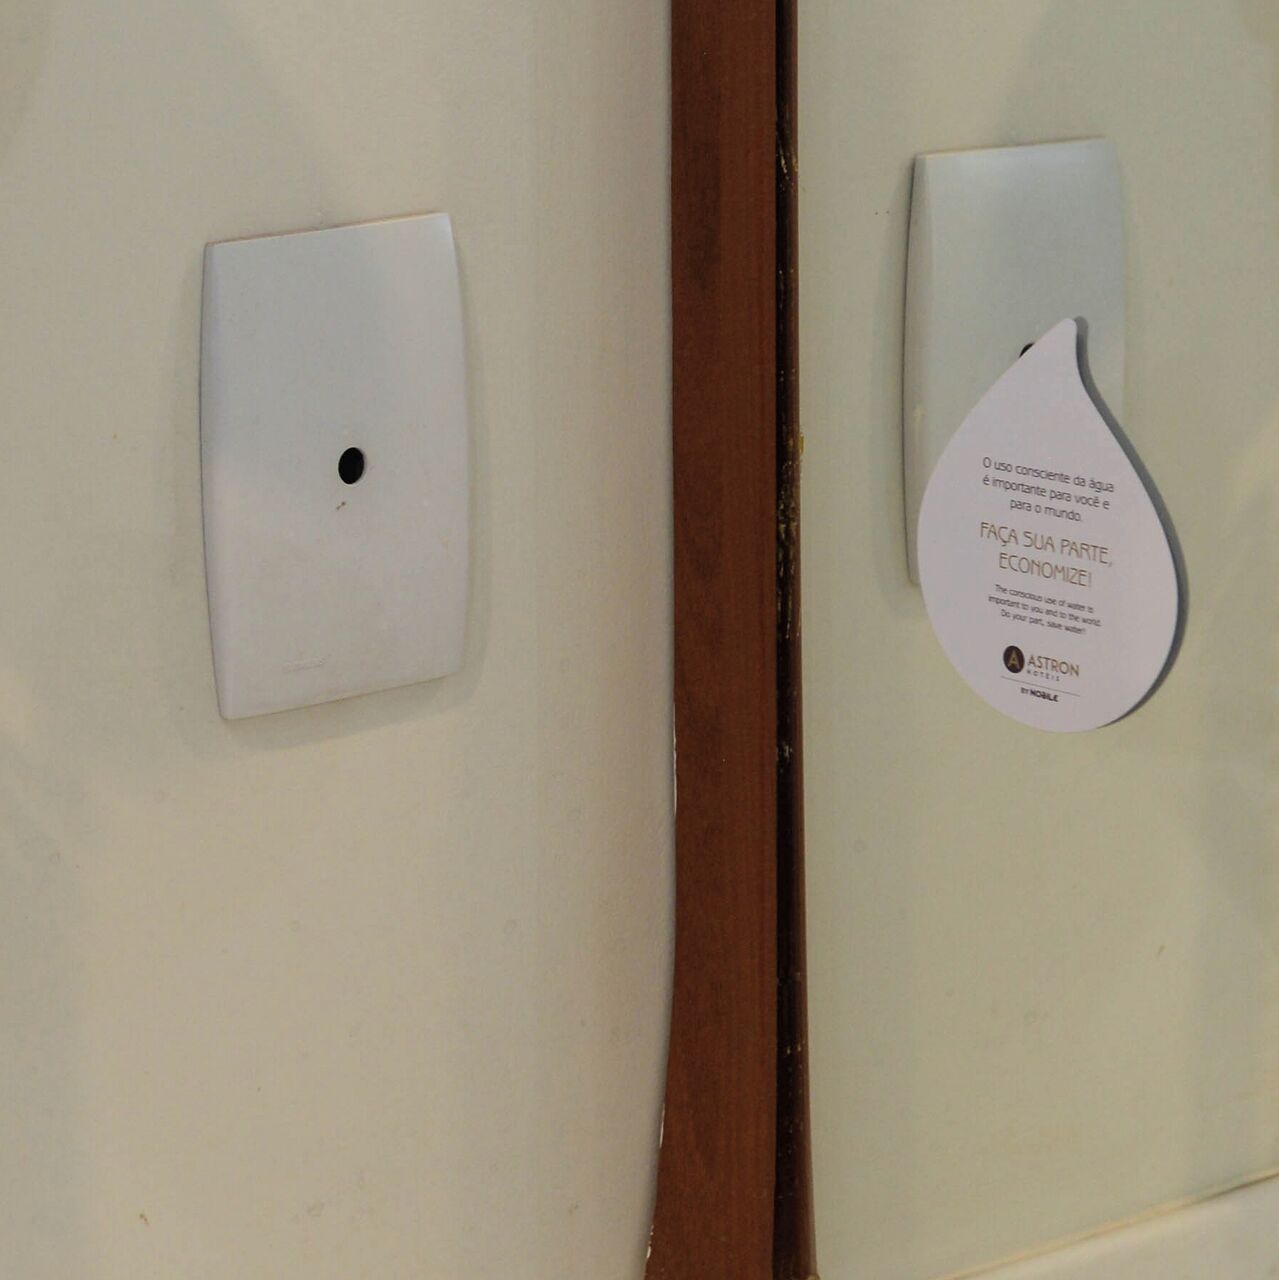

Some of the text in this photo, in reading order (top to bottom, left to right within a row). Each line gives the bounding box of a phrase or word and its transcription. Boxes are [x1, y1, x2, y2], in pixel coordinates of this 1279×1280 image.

[982, 456, 1114, 493] O uso consciente da água
[982, 474, 1110, 510] é importante para você e
[1010, 499, 1032, 511] para
[1034, 504, 1042, 514] o
[980, 522, 1112, 567] FAÇA SUA PARTE,
[999, 552, 1092, 587] ECONOMIZE!
[995, 584, 1007, 594] The
[1009, 589, 1042, 602] conscious
[1044, 597, 1056, 606] use
[1067, 602, 1086, 612] water
[1027, 654, 1080, 677] ASTRON
